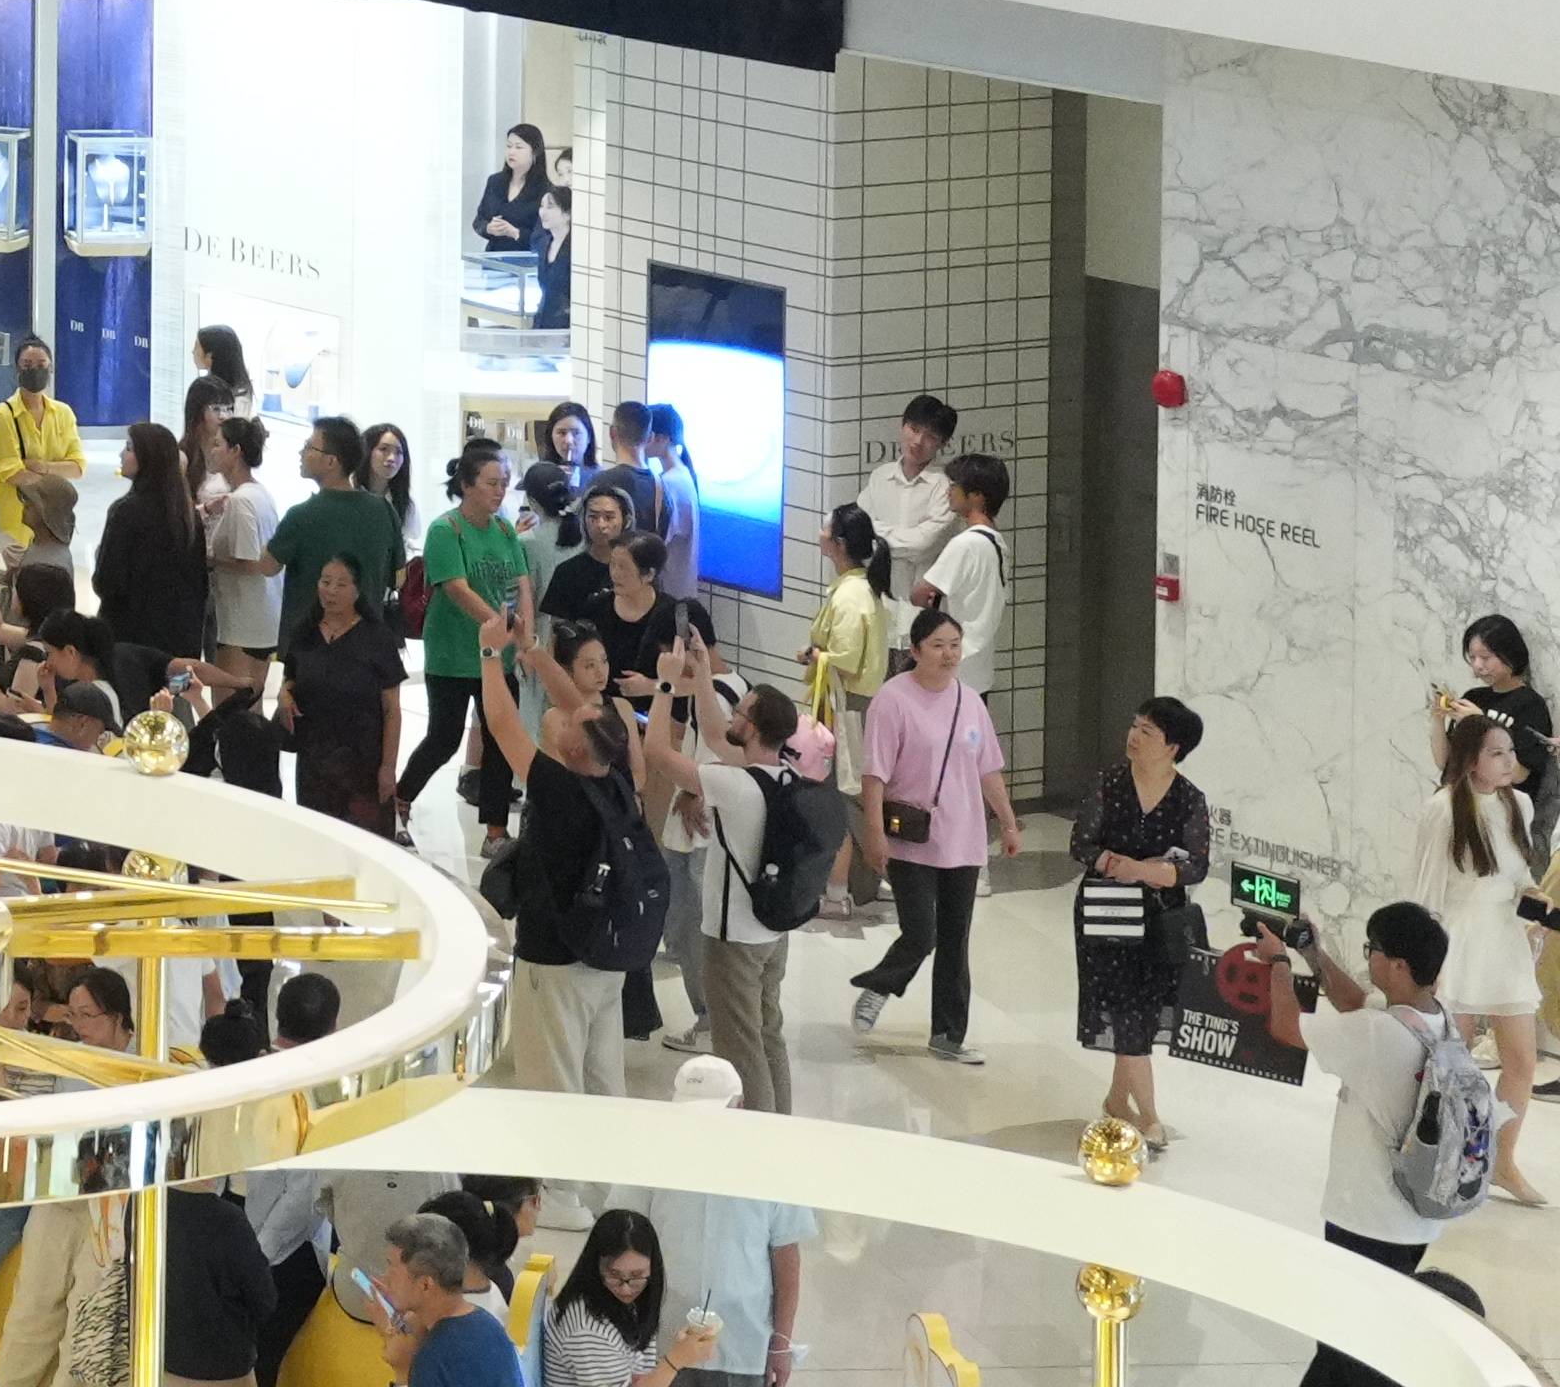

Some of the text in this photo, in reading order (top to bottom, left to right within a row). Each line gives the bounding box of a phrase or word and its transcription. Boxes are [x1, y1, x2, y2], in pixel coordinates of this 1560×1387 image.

[184, 226, 322, 282] DE BEERS
[70, 319, 85, 333] DB
[102, 327, 117, 340] DB
[134, 335, 149, 349] DB
[1196, 482, 1237, 507] 消防栓
[1196, 503, 1321, 549] FIRE HOSE REEL
[1182, 1008, 1241, 1036] THE TING'S
[1177, 1023, 1238, 1059] SHOW
